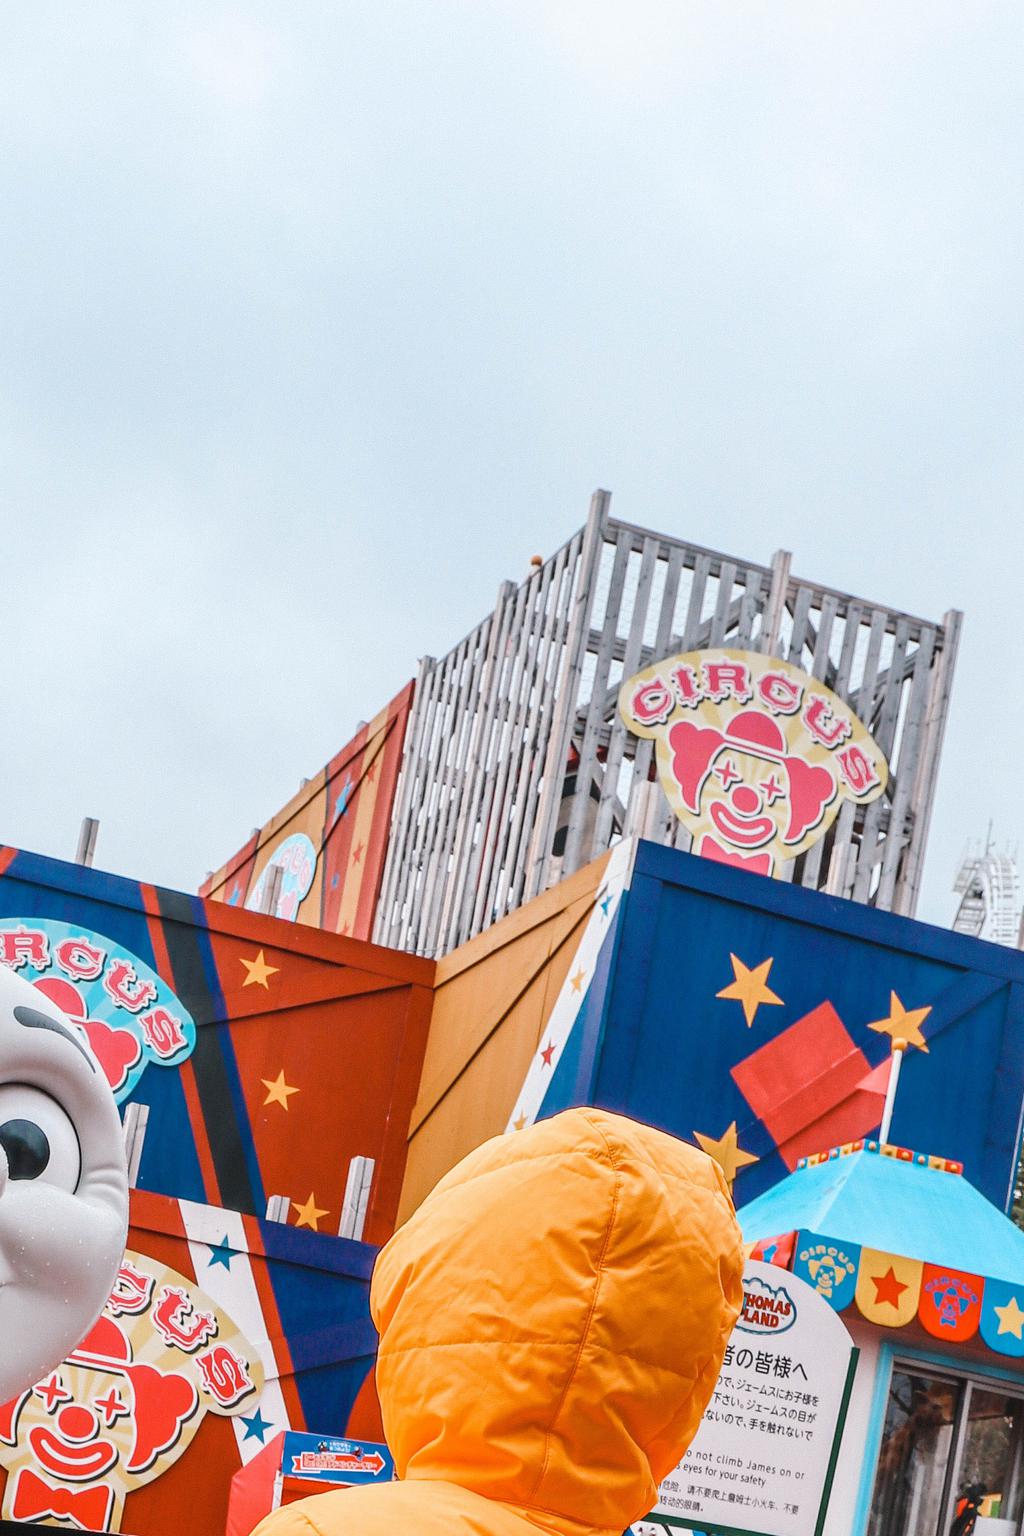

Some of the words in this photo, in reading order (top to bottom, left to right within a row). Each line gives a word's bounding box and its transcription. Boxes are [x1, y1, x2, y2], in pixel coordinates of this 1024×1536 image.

[632, 660, 880, 795] CIRCUS
[799, 1244, 855, 1275] CIRCUS
[743, 1309, 779, 1328] LAND
[702, 1409, 814, 1441] ないので、手を触れないで
[683, 1463, 703, 1475] eyes
[705, 1465, 718, 1477] for
[719, 1470, 739, 1482] your
[740, 1473, 767, 1489] safety
[696, 1450, 713, 1462] not
[716, 1454, 744, 1468] climb
[746, 1460, 777, 1475] James
[779, 1468, 792, 1478] on
[794, 1471, 806, 1480] or
